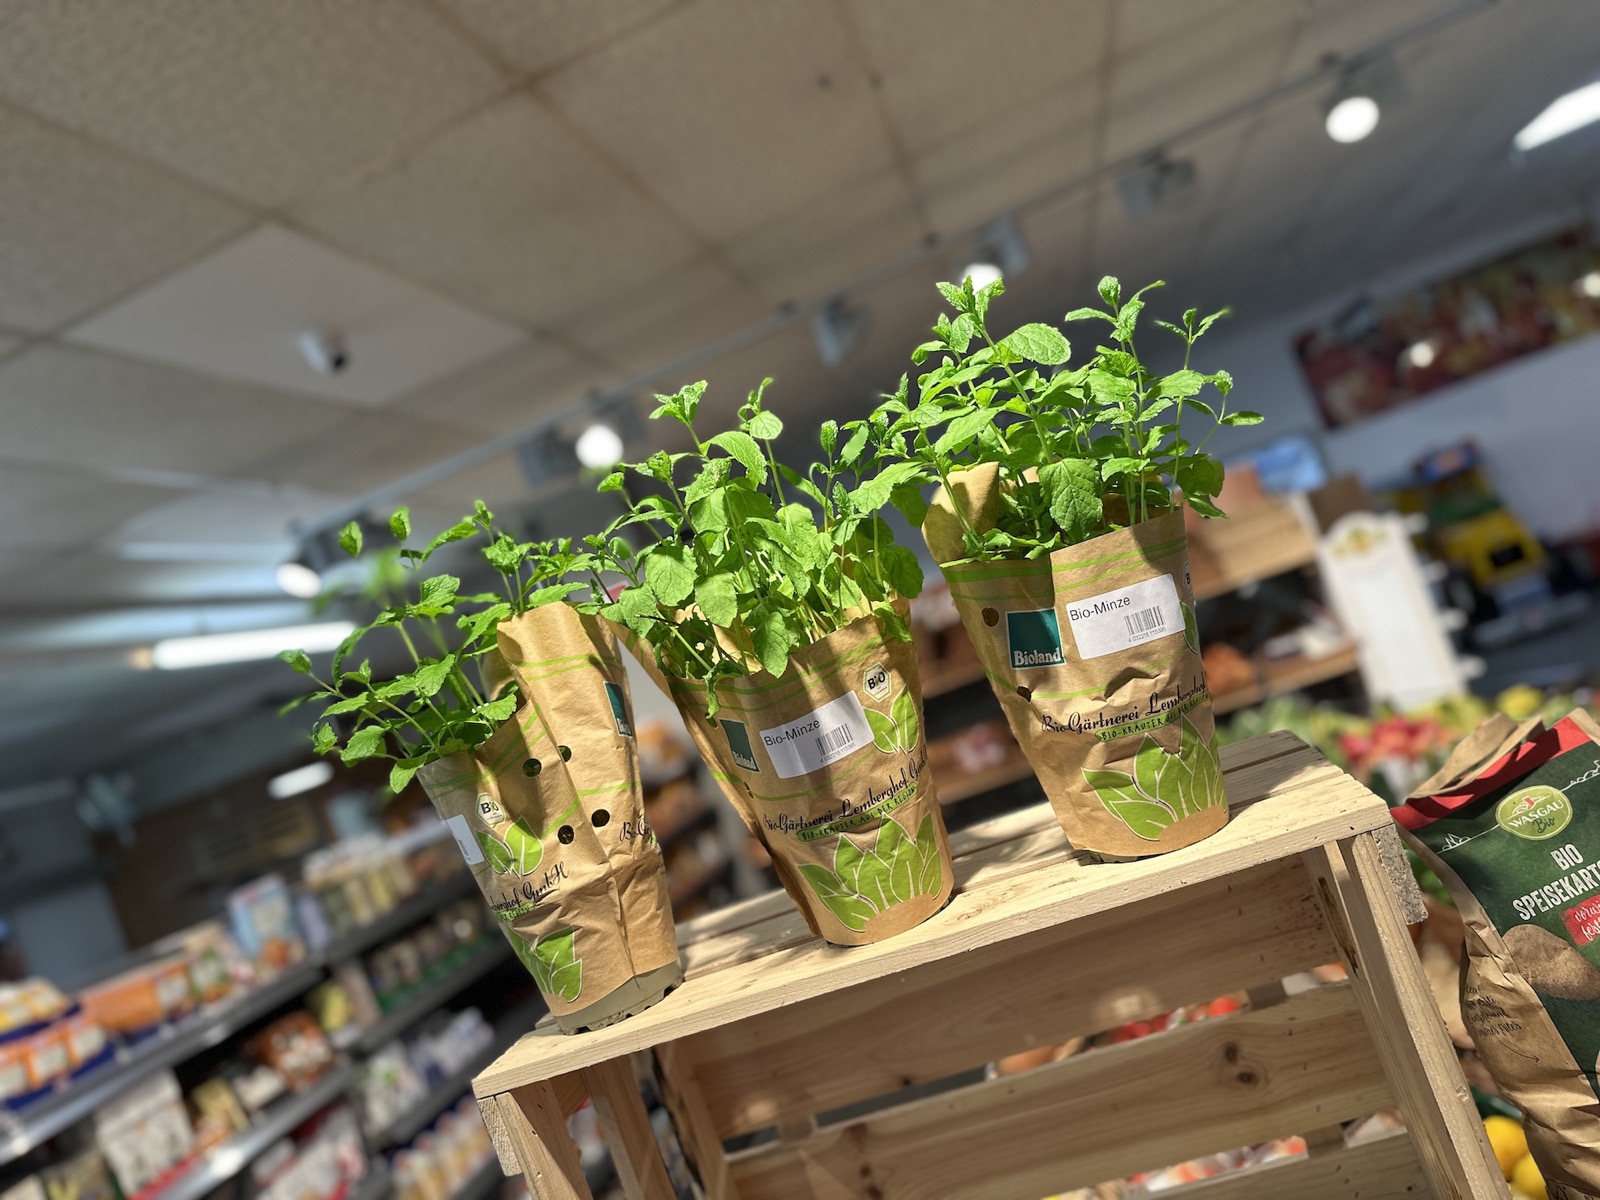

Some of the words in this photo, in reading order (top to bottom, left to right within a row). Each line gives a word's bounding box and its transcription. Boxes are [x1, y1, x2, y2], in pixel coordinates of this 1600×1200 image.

[1069, 596, 1131, 621] Bio-Minze
[1013, 646, 1062, 666] Bioland
[763, 720, 820, 746] Bio-Minze
[1101, 718, 1164, 741] BIO-KRÄUTER
[839, 767, 909, 819] Lemberghof
[802, 819, 856, 840] BIO-KRÄUTER
[877, 803, 893, 816] DER
[893, 785, 915, 806] REGION
[1508, 799, 1565, 828] WASGAU
[1532, 815, 1556, 834] Bio
[1550, 843, 1584, 871] BIO
[522, 861, 569, 902] GmbH
